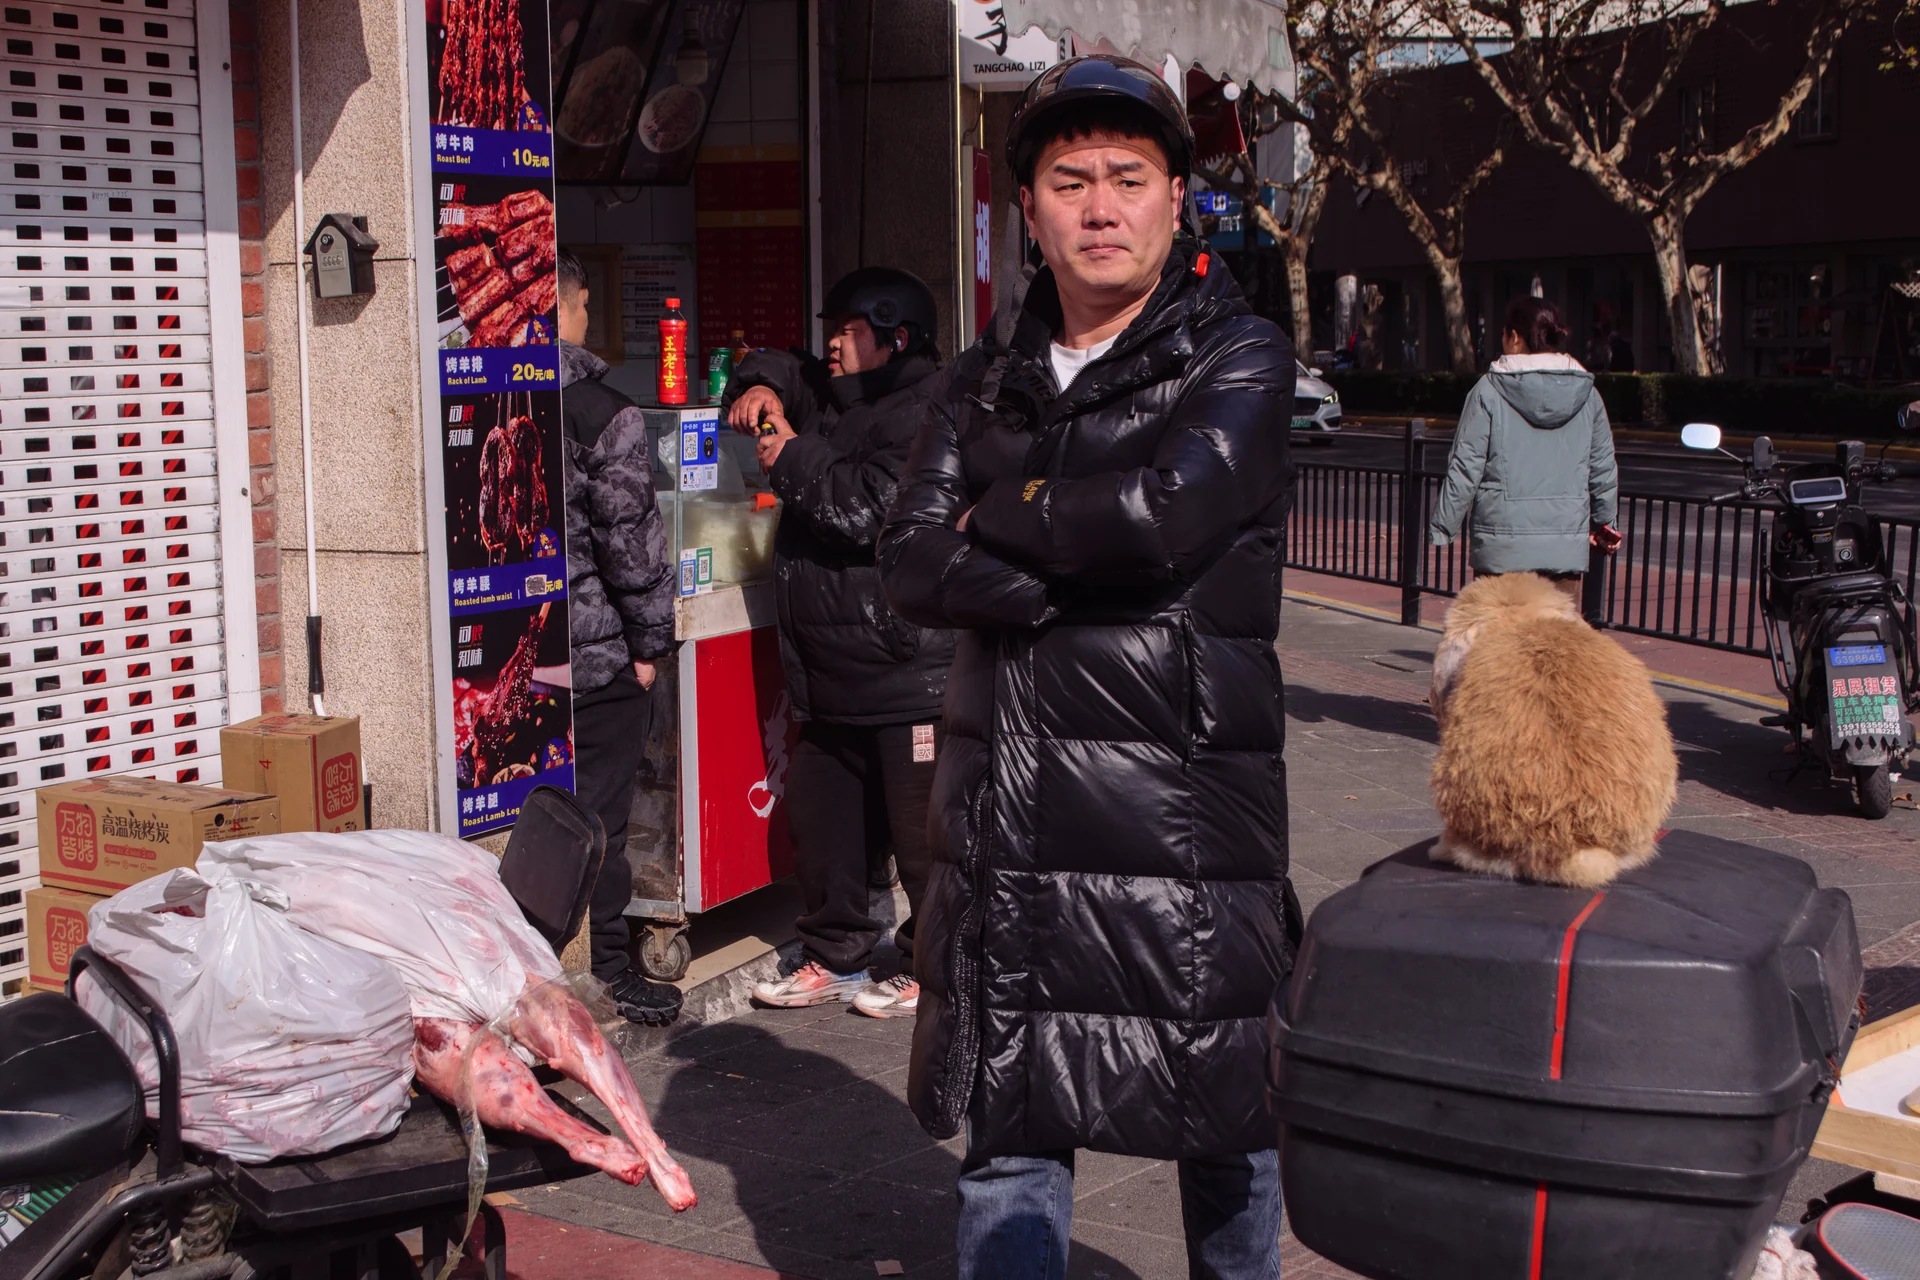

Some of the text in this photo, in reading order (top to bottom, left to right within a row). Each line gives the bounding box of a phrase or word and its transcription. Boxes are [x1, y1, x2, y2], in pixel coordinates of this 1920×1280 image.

[973, 61, 1046, 74] TANGCHAO LIZI
[435, 133, 475, 152] 烤牛肉
[436, 154, 471, 164] Roast Beef
[512, 148, 550, 168] 10元/串
[439, 207, 465, 226] 知味
[445, 355, 483, 374] 烤羊排
[663, 335, 678, 389] 王老吉
[447, 376, 488, 386] Rack of Lamb
[512, 363, 555, 381] 20元/串
[447, 428, 474, 447] 知味
[453, 575, 491, 595] 烤羊腰
[454, 592, 513, 607] Roasted lamb waist
[457, 648, 483, 668] 知味
[462, 792, 499, 814] 烤羊腿
[59, 809, 93, 837] 万物
[463, 807, 521, 827] Roast Lamb Leg
[102, 813, 170, 844] 高温烧烤炭
[50, 914, 85, 943] 万物
